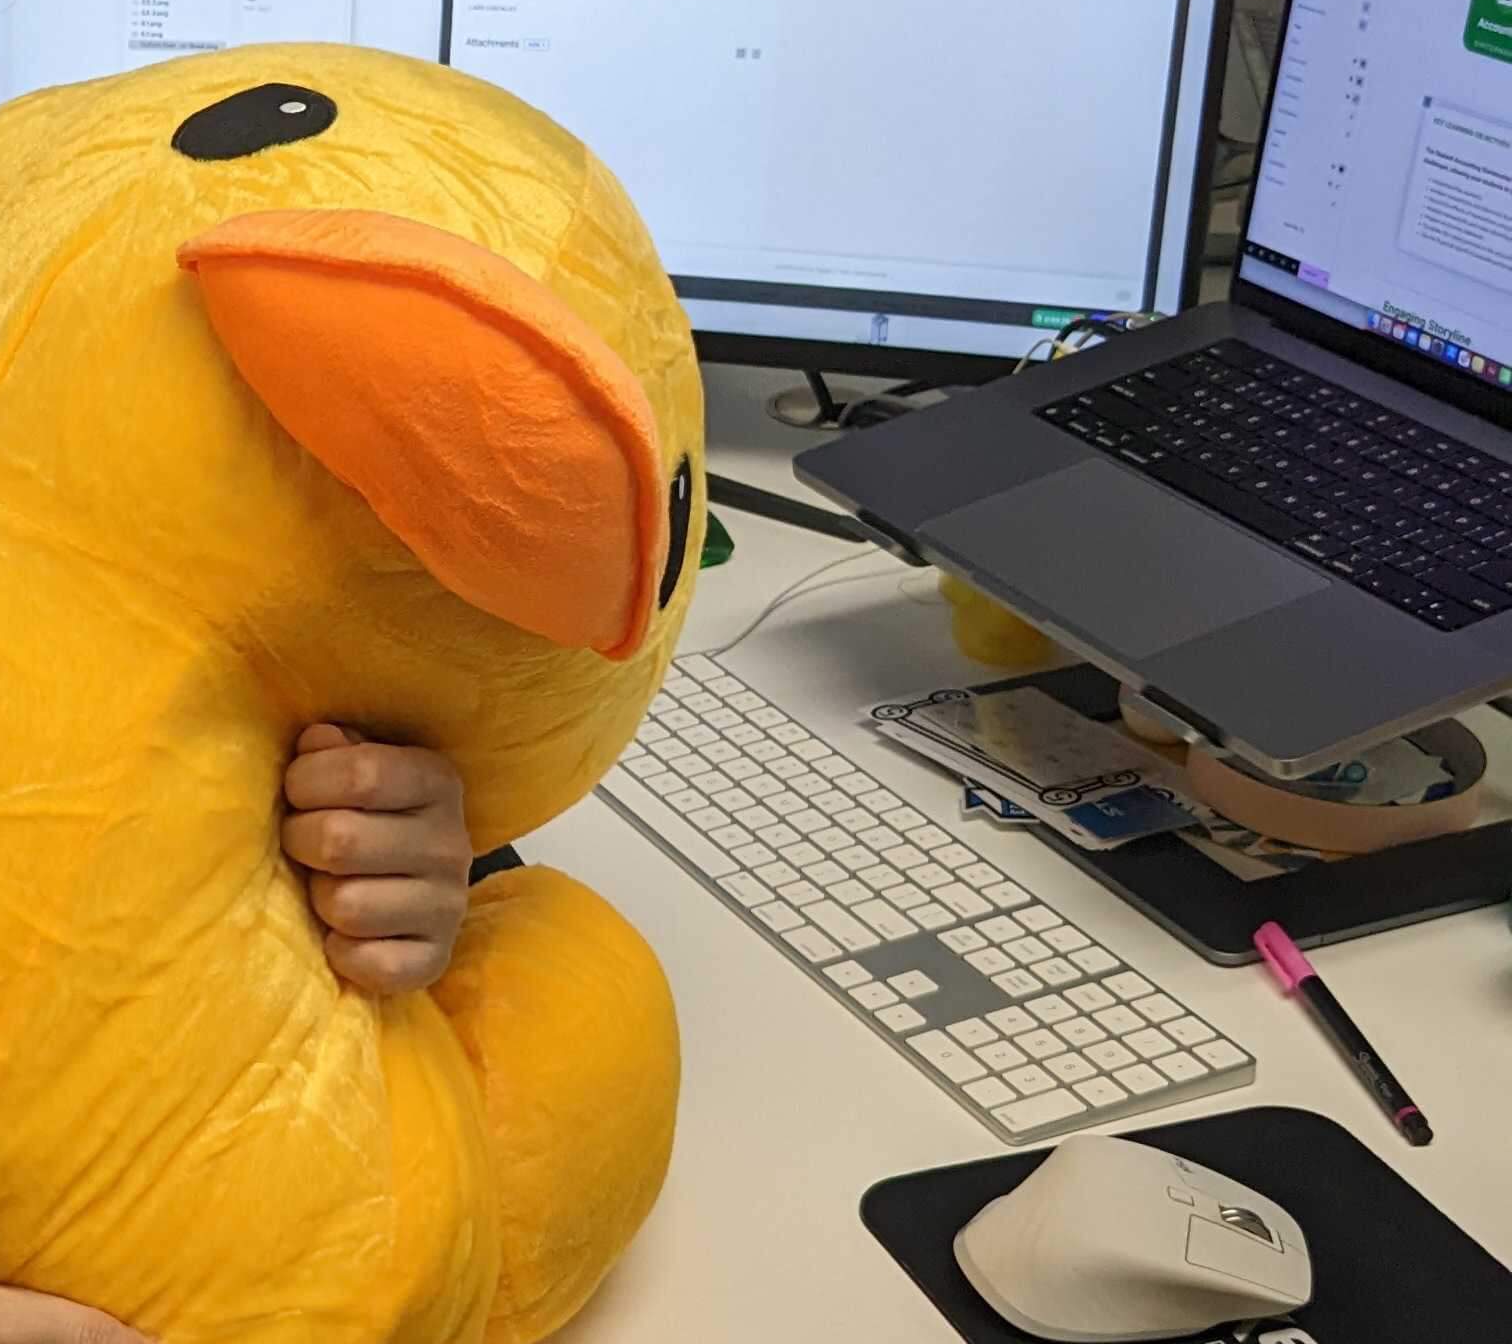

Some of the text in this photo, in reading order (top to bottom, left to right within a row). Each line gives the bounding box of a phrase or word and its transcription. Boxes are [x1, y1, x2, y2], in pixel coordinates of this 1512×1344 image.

[465, 37, 519, 49] Attachments
[1382, 300, 1472, 347] Engaging Storyline
